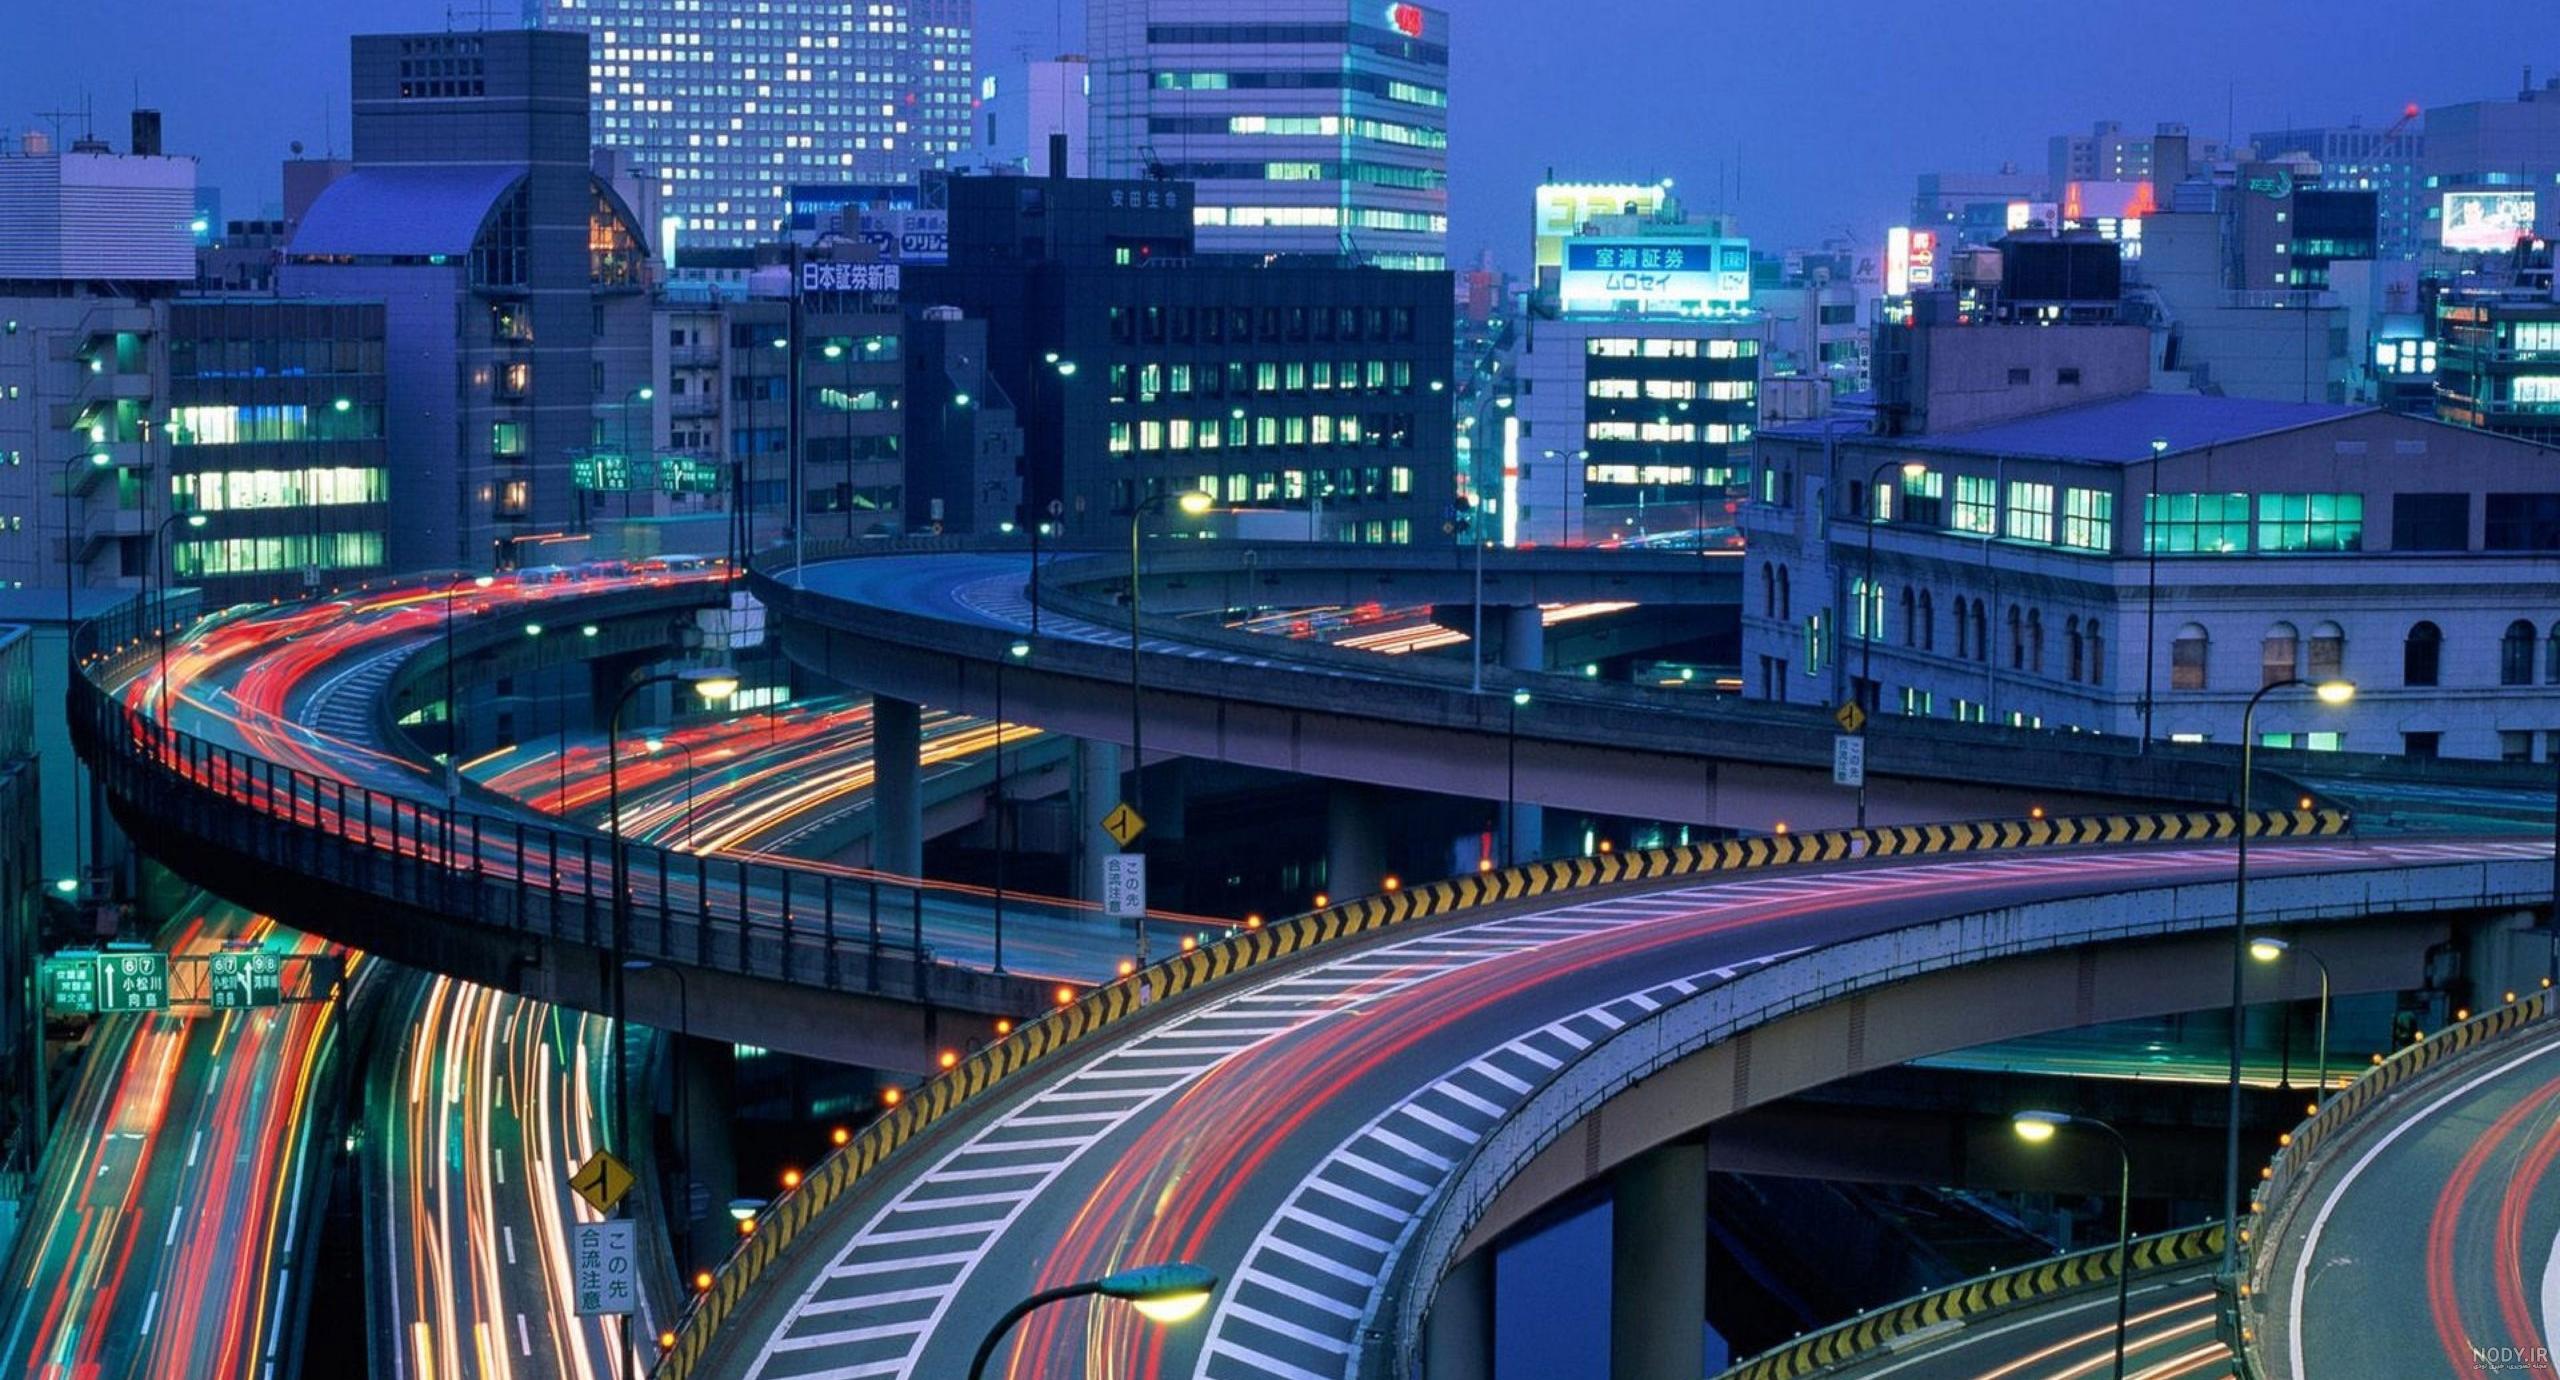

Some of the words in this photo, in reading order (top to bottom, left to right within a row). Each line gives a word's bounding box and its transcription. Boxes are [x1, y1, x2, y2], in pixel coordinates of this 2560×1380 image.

[803, 263, 899, 290] 日本証券新聞
[1606, 273, 1671, 291] ムロセイ
[1126, 862, 1139, 907] この先
[122, 976, 162, 991] 小松川
[581, 1228, 601, 1310] 合流注意
[608, 1232, 628, 1299] この先
